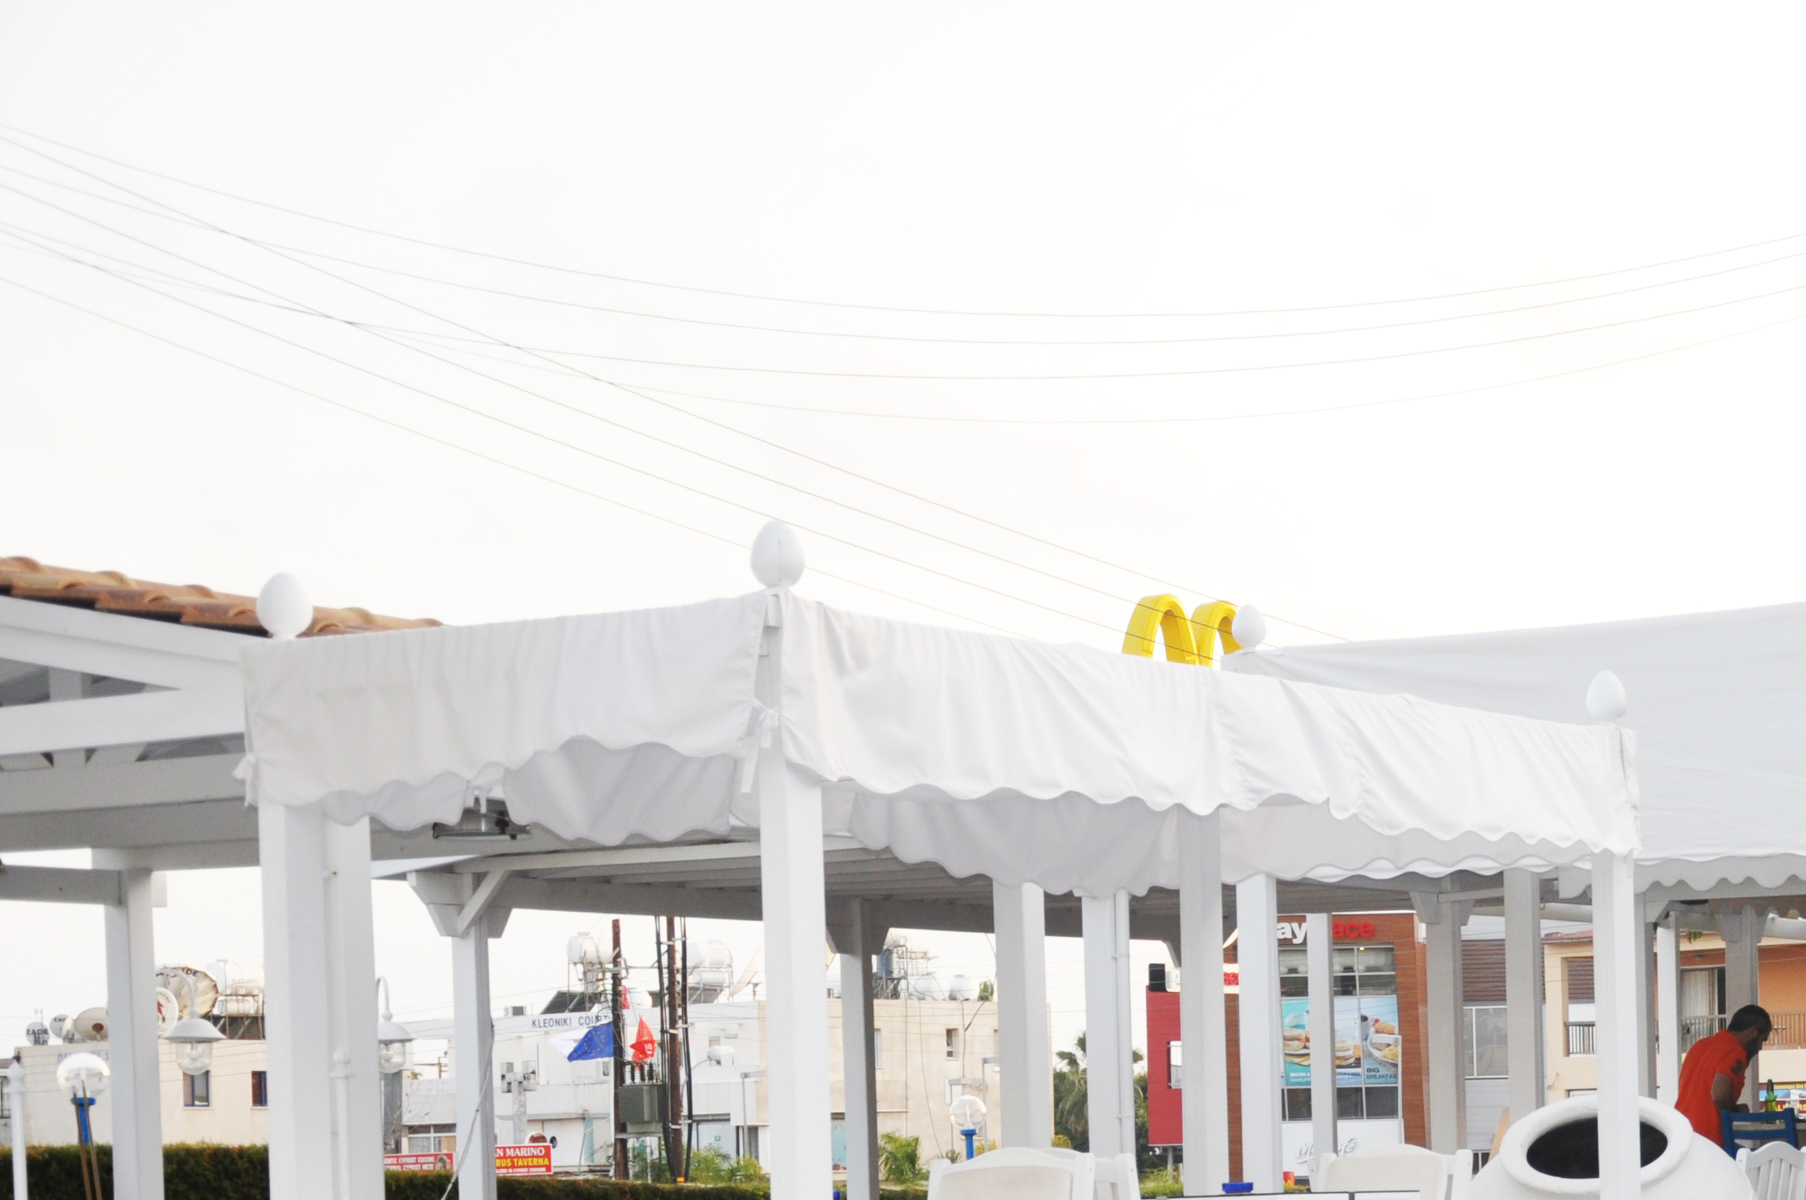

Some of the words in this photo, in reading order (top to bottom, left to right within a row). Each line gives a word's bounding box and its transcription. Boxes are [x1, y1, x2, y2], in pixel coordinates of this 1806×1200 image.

[532, 1017, 572, 1029] KLEONIKI
[505, 1147, 545, 1157] MARINO
[513, 1157, 549, 1167] TAVERNA
